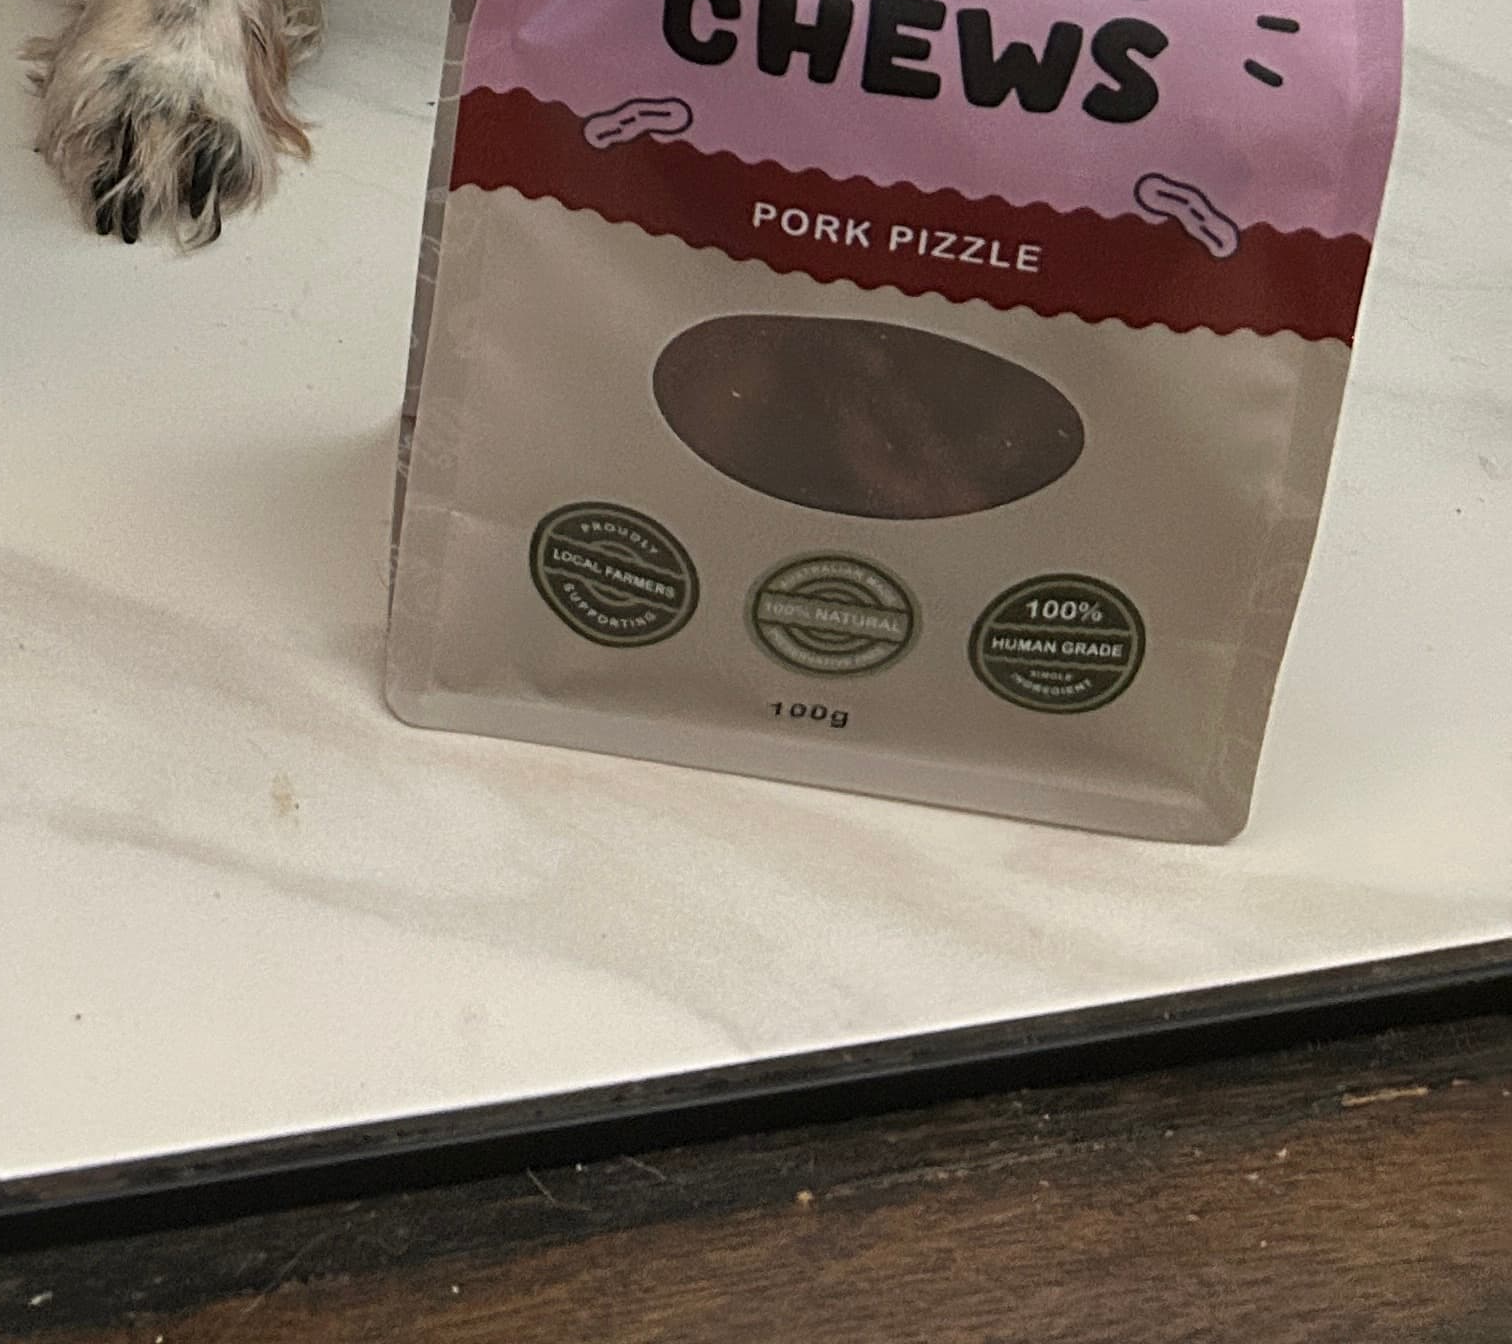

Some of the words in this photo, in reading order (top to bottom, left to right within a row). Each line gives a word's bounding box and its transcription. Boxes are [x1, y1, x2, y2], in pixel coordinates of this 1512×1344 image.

[752, 201, 873, 250] PORK
[888, 224, 1042, 274] PIZZLE
[580, 521, 659, 554] PROUDLY
[553, 548, 602, 574] LOCAL
[605, 565, 675, 599] FARMERS
[563, 582, 657, 629] SUPPORTING
[815, 608, 899, 633] NATURAL
[1026, 599, 1103, 622] 100%
[991, 637, 1057, 654] HUMAN
[1061, 640, 1124, 657] GRADE
[769, 701, 849, 729] 100g
